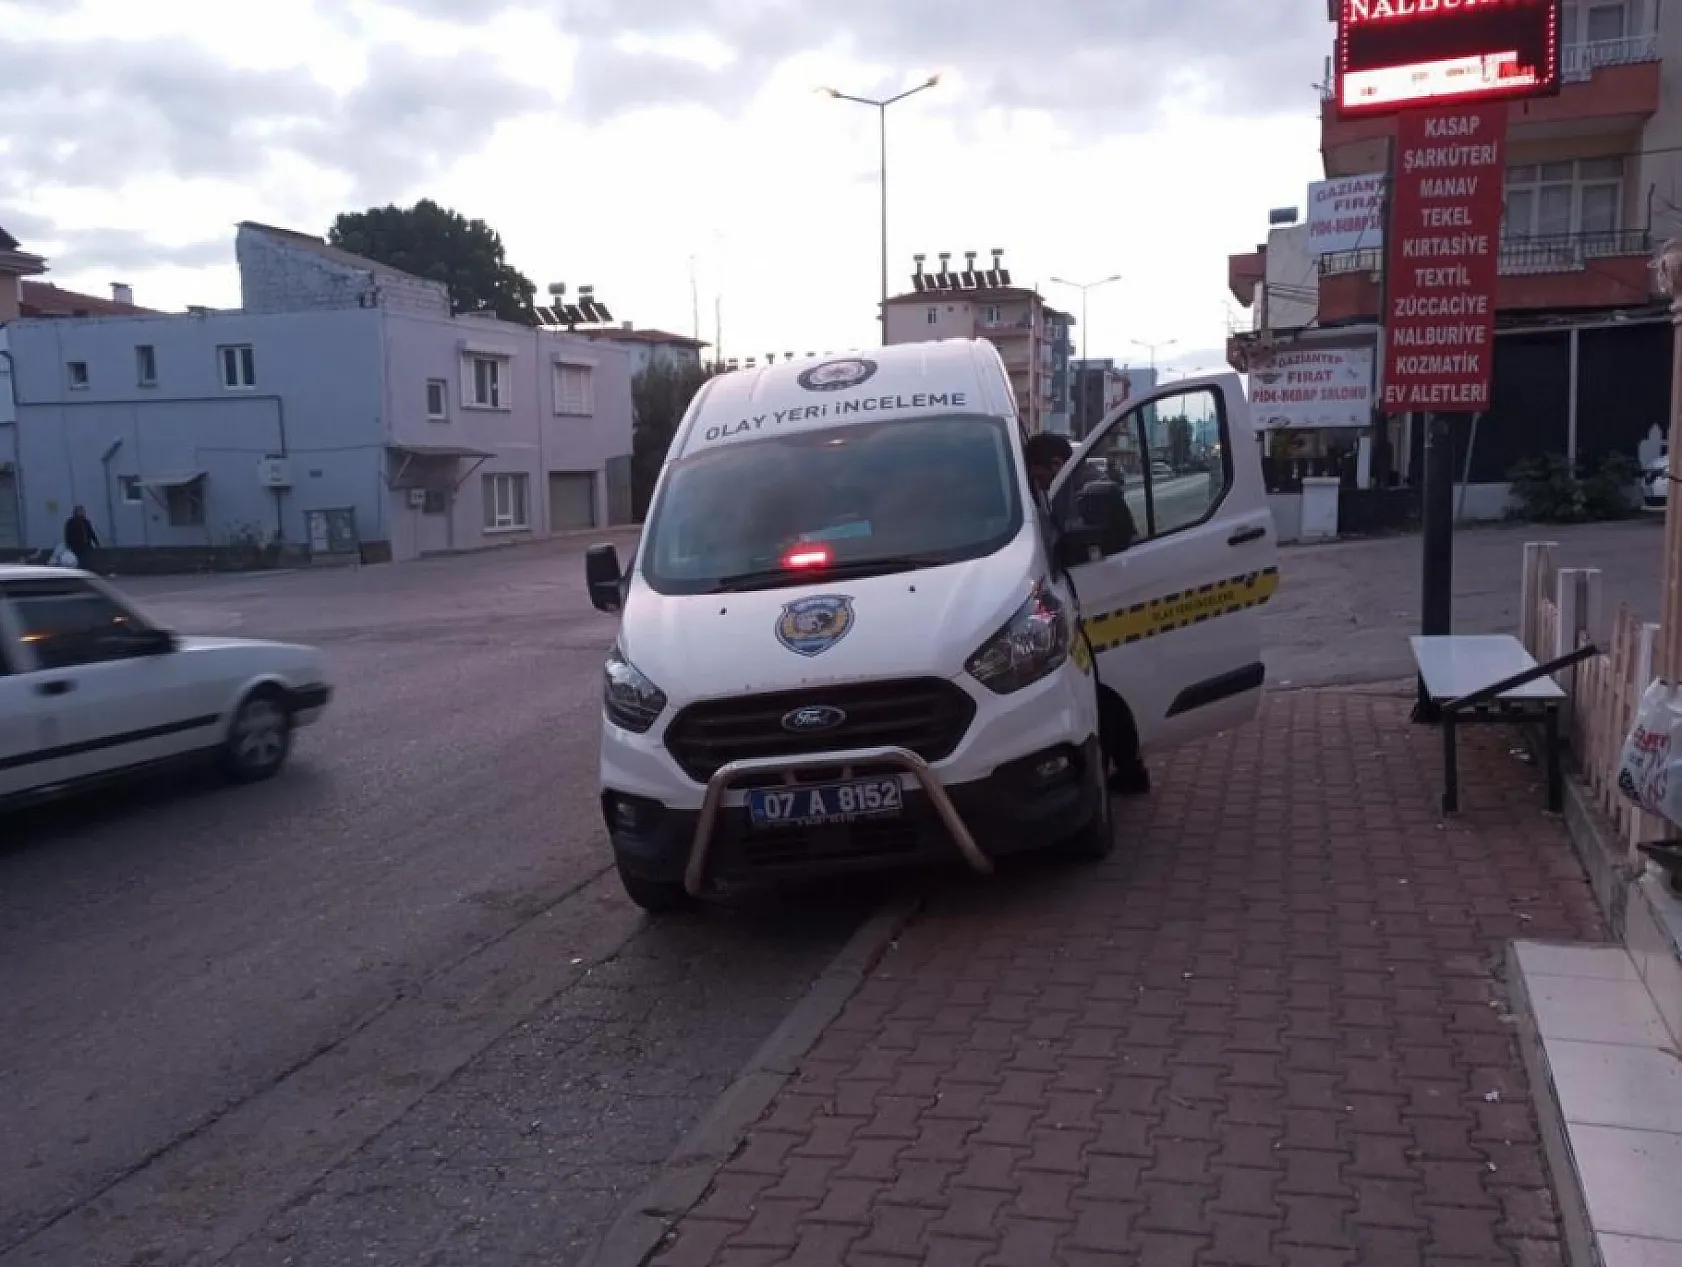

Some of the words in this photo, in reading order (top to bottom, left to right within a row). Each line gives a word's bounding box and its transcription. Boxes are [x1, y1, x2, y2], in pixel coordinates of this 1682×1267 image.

[1424, 116, 1480, 137] KASAP
[1403, 140, 1497, 172] ŞARKÜTERİ
[1420, 176, 1478, 197] MANAV
[1421, 207, 1472, 226] TEKEL
[1403, 235, 1489, 257] KIRTASİYE
[1415, 262, 1471, 288] TEXTİL
[1394, 295, 1488, 317] ZÜCCACİYE
[1394, 321, 1486, 346] NALBURİYE
[1395, 352, 1480, 375] KOZMATİK
[1384, 386, 1406, 403] EV
[1409, 379, 1488, 403] ALETLERİ
[706, 415, 767, 441] OLAY
[763, 792, 796, 819] 07
[809, 788, 826, 815] A
[838, 781, 897, 811] 8152
